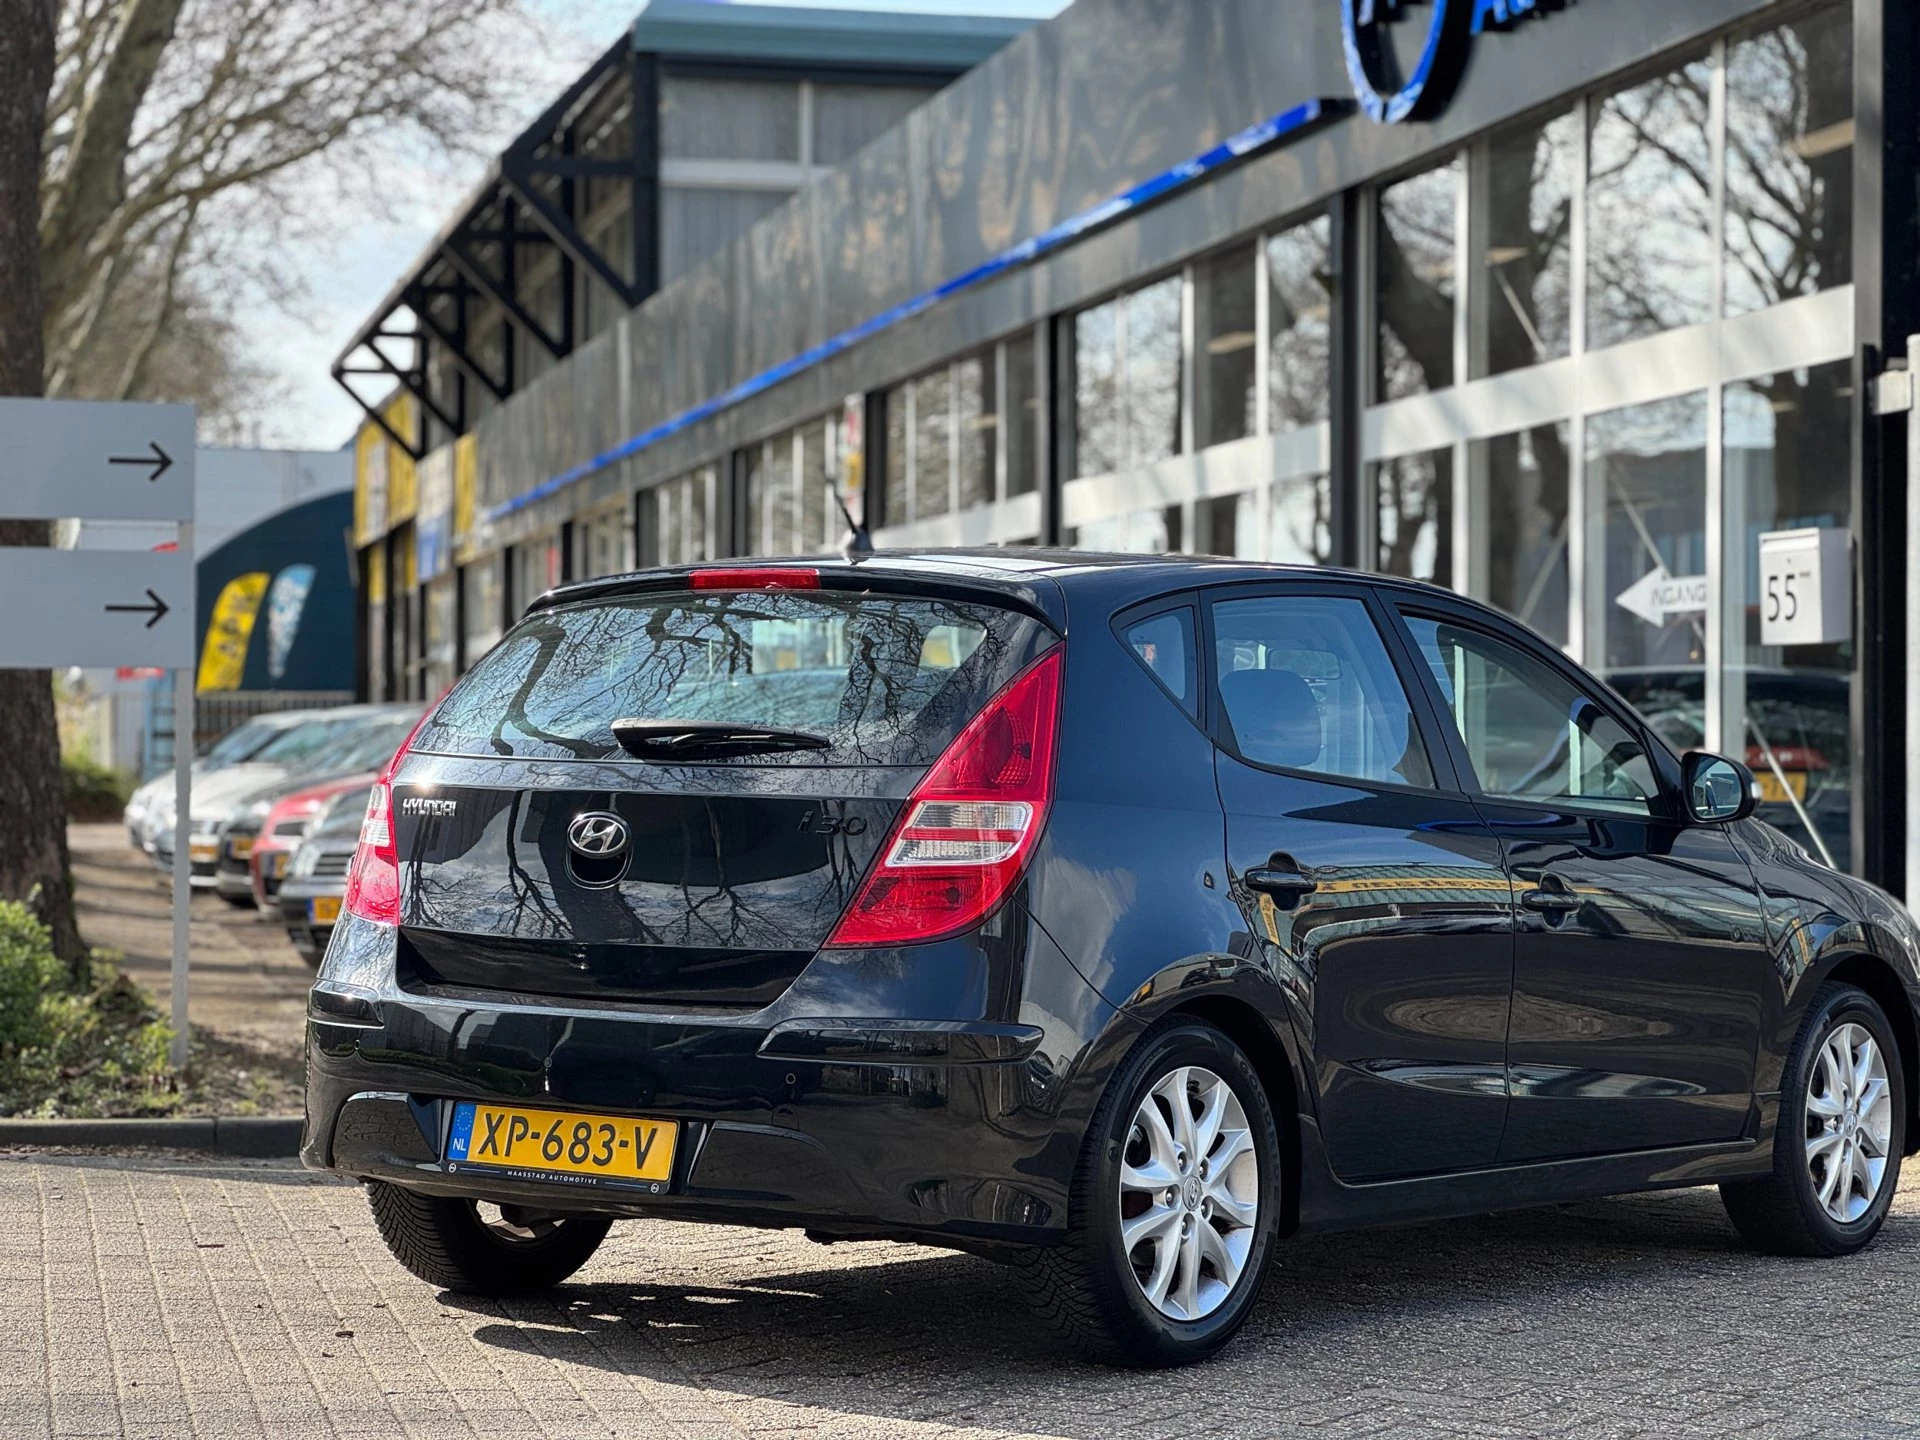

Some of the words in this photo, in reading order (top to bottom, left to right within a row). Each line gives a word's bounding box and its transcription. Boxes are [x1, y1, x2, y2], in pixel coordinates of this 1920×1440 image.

[1767, 573, 1797, 622] 55
[402, 798, 457, 816] HYUNDAI
[453, 1138, 467, 1151] NL
[477, 1112, 659, 1170] XP-683-V
[506, 1170, 546, 1180] MAASSTAD
[548, 1174, 598, 1185] AUTOMOTIVE
